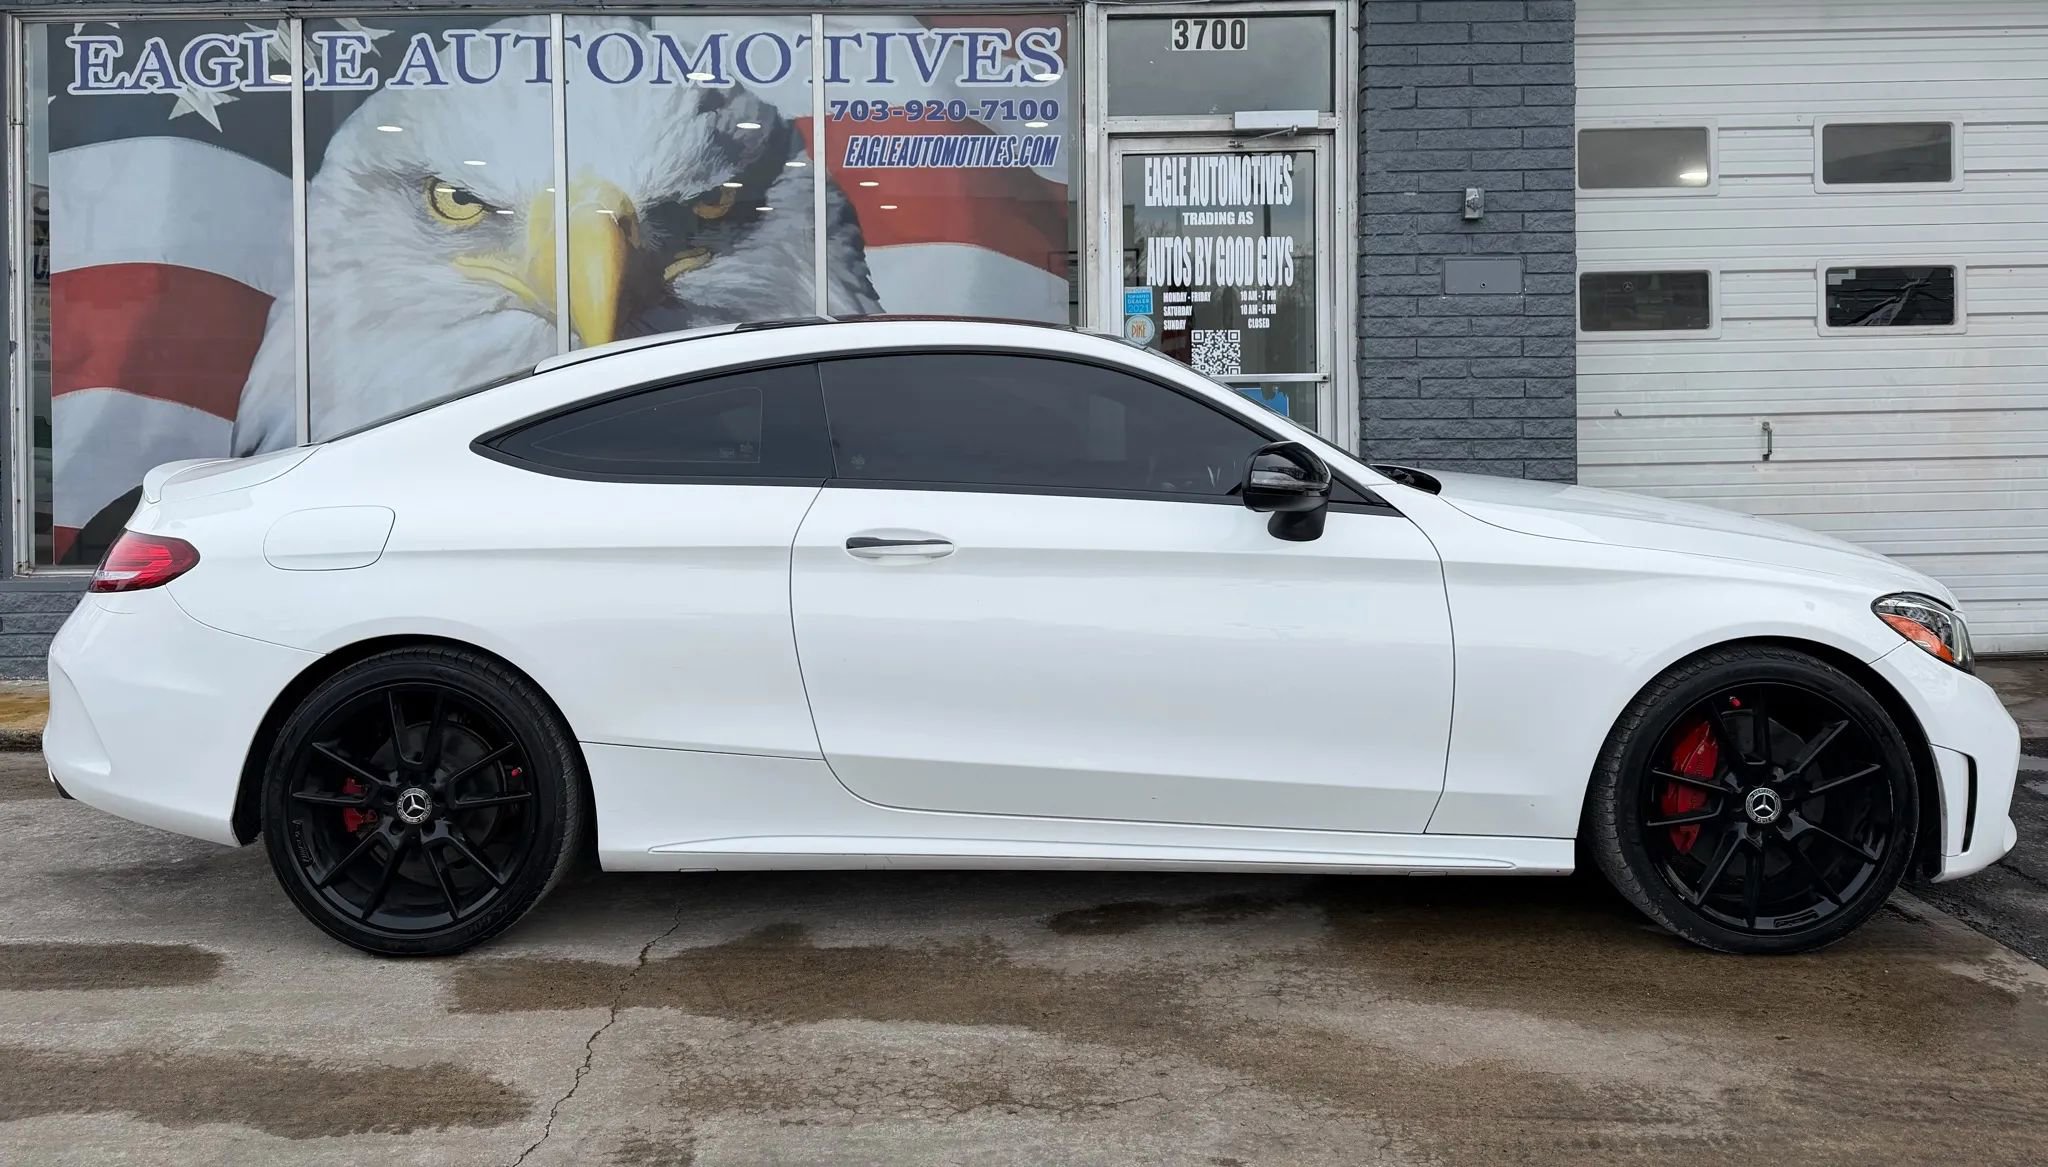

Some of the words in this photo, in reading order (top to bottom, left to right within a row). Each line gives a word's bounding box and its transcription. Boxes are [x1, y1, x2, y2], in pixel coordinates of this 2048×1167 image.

[1174, 19, 1246, 50] 3700
[67, 33, 378, 95] EAGLE
[387, 28, 1063, 91] AUTOMOTIVES
[830, 99, 1060, 122] 703-920-7100
[843, 134, 1061, 168] EAGLEAUTOMOTIVES.COM
[1145, 156, 1187, 207] EAGLE
[1190, 155, 1293, 206] AUTOMOTIVES
[1182, 212, 1236, 226] TRADING
[1238, 211, 1254, 225] AS
[1147, 236, 1192, 287] AUTOS
[1195, 236, 1214, 287] BY
[1216, 236, 1254, 287] GOOD
[1257, 236, 1294, 287] GUYS
[1163, 292, 1187, 303] MONDAY
[1191, 291, 1211, 302] FRIDAY
[1240, 291, 1248, 301] 10
[1248, 291, 1258, 301] AM
[1261, 290, 1265, 301] 7
[1266, 290, 1277, 300] PM
[1128, 304, 1150, 313] 2021
[1163, 305, 1193, 316] SATURDAY
[1240, 304, 1248, 315] 10
[1266, 303, 1277, 314] PM
[1163, 319, 1187, 330] SUNDAY
[1248, 318, 1270, 329] CLOSED
